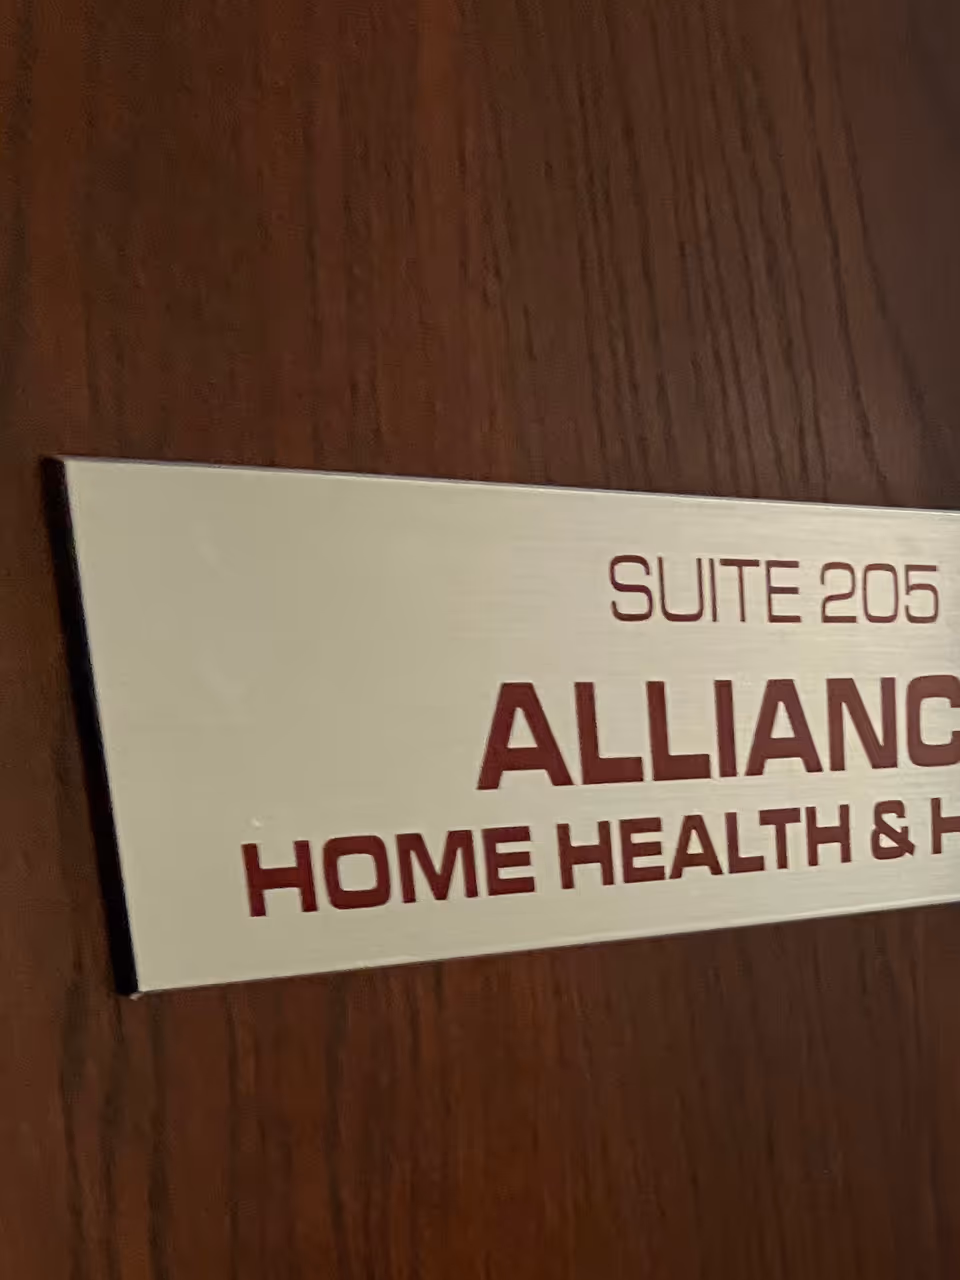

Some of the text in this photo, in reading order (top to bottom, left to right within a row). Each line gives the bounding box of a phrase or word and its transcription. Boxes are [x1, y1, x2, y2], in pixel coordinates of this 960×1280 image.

[608, 553, 941, 626] SUITE 205
[241, 826, 536, 919] HOME
[556, 805, 853, 891] HEALTH
[870, 799, 916, 861] &
